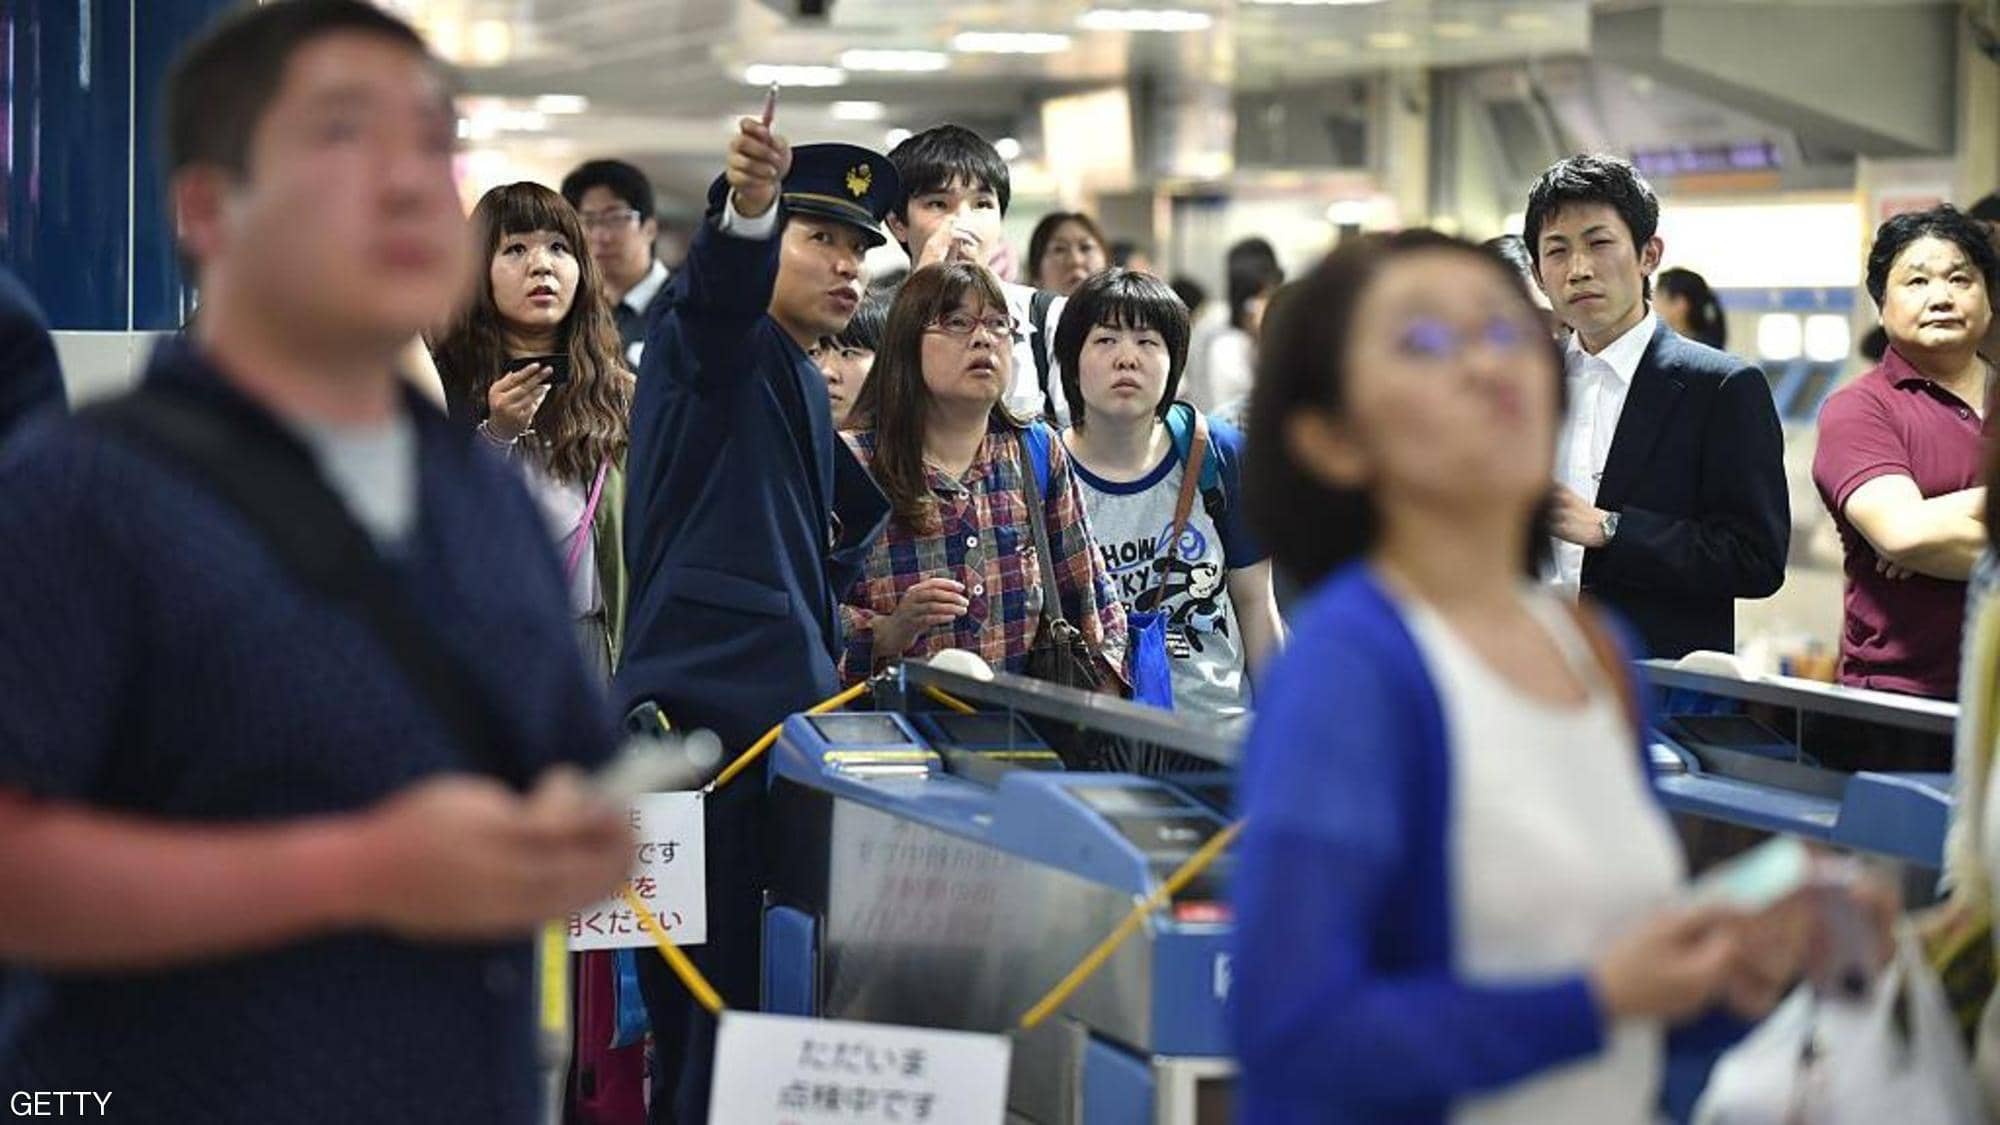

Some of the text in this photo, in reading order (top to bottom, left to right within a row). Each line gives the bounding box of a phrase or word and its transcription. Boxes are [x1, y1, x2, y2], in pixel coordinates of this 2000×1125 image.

[637, 839, 680, 864] です
[799, 1039, 926, 1076] ただいま
